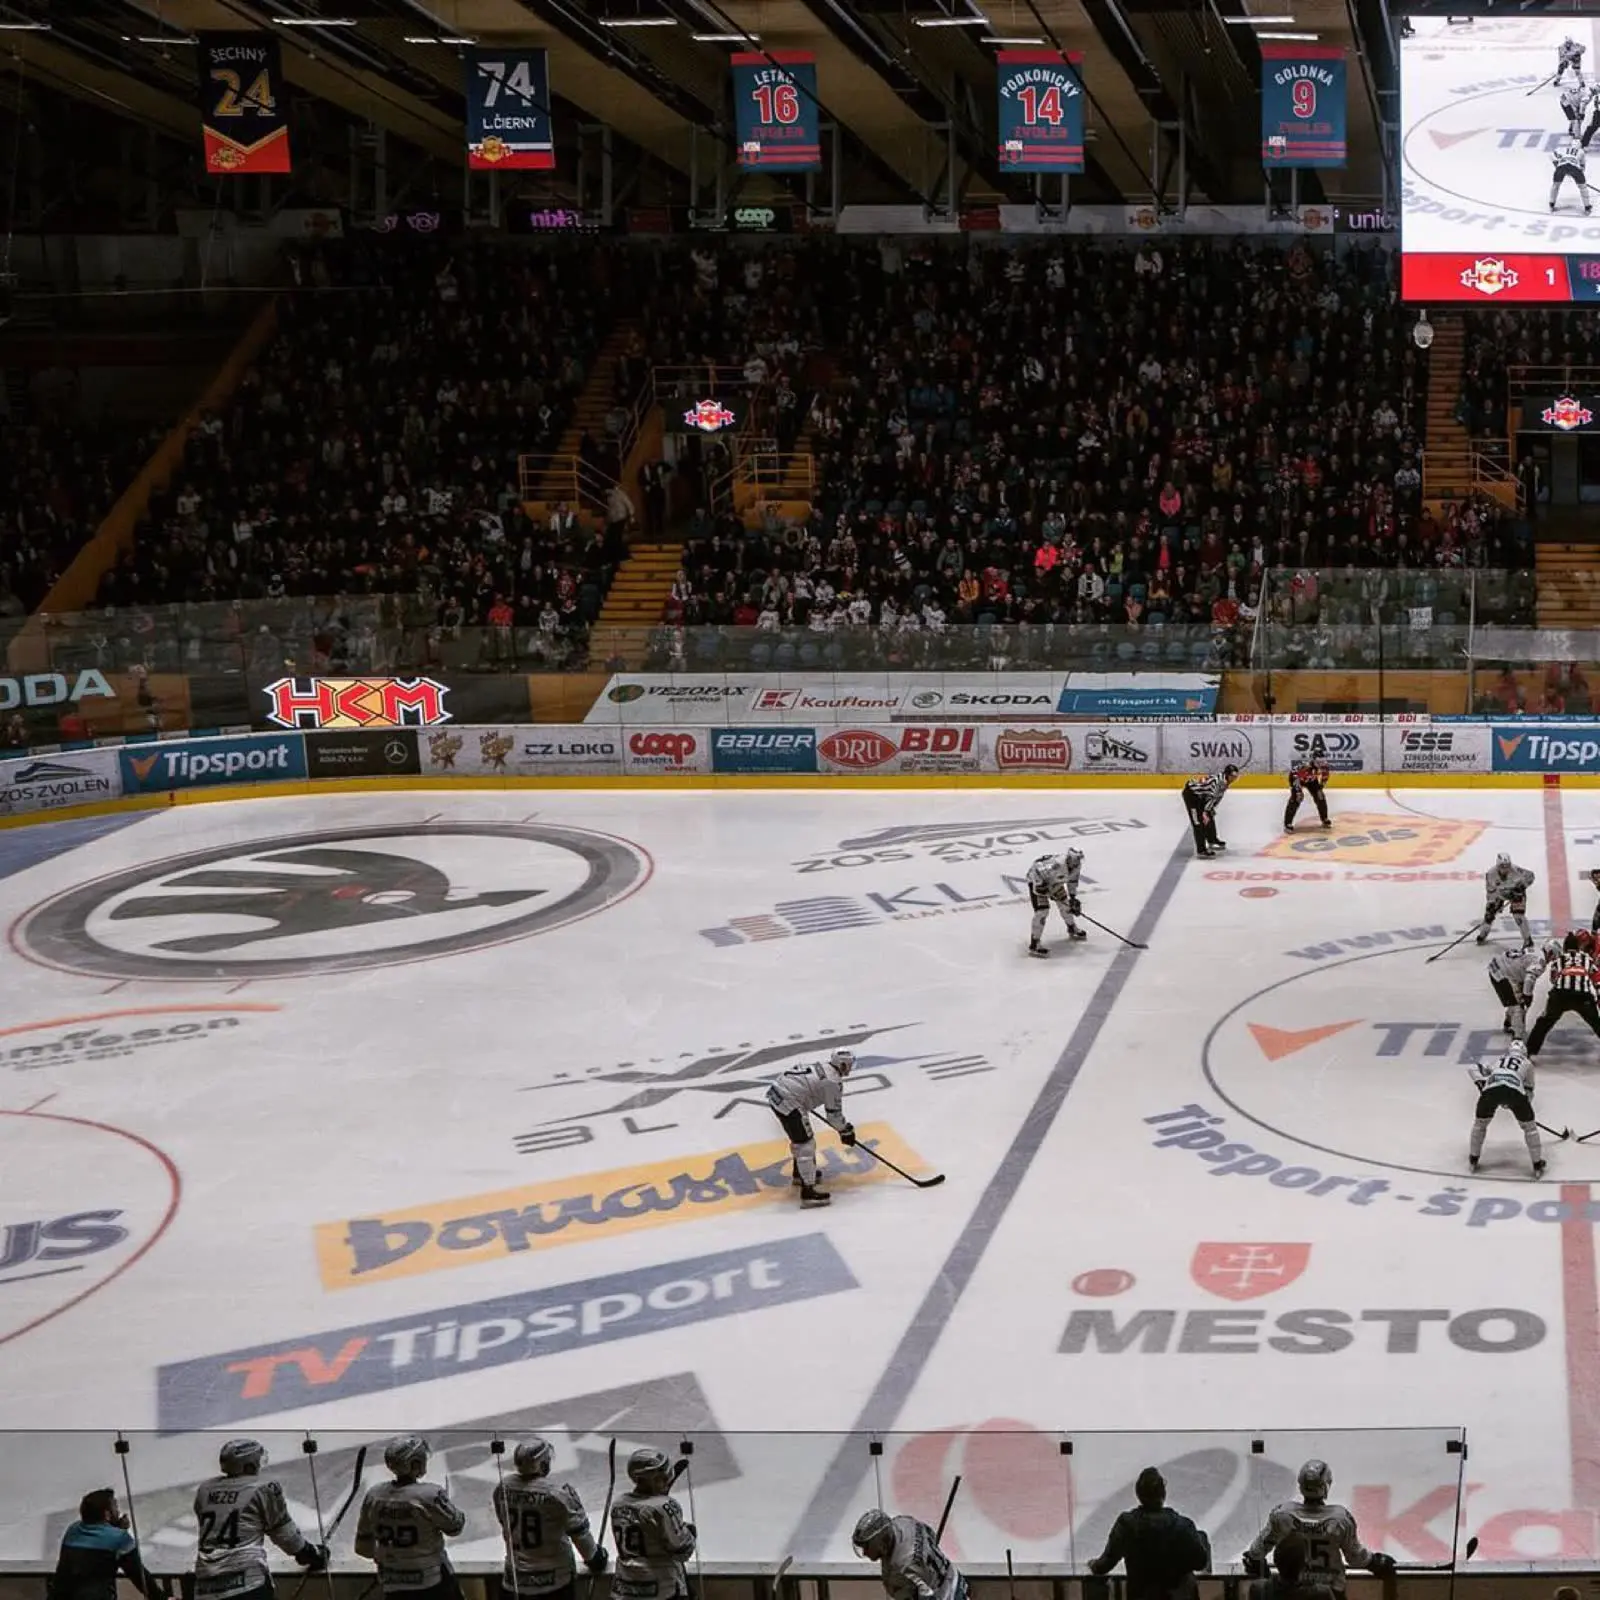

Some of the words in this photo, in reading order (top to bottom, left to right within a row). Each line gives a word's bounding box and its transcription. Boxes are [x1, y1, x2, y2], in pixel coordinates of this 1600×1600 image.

[476, 61, 536, 107] 74
[1274, 64, 1334, 86] GOLONKA
[210, 68, 276, 117] 24
[752, 84, 799, 124] 16
[1292, 79, 1316, 119] 9
[1017, 85, 1064, 125] 14
[1545, 267, 1556, 286] 1
[800, 695, 898, 709] Kaufland
[949, 691, 1052, 705] ŠKODA
[525, 744, 553, 755] CZ
[558, 743, 615, 755] LOKO
[629, 733, 697, 764] coop
[834, 738, 881, 760] DRU
[900, 728, 975, 752] BDI
[1001, 741, 1064, 763] Urpiner
[1190, 742, 1243, 758] SWAN
[164, 743, 289, 780] Tipsport
[37, 778, 110, 799] ZVOLEN
[791, 848, 913, 874] ZOS
[921, 817, 1150, 856] ZVOLEN
[1290, 828, 1419, 853] Geis
[1203, 870, 1334, 882] Global
[1498, 1057, 1522, 1072] 16
[225, 1336, 371, 1399] TV
[375, 1256, 786, 1368] Tipsport
[1056, 1307, 1547, 1355] MESTO
[199, 1510, 240, 1551] 24
